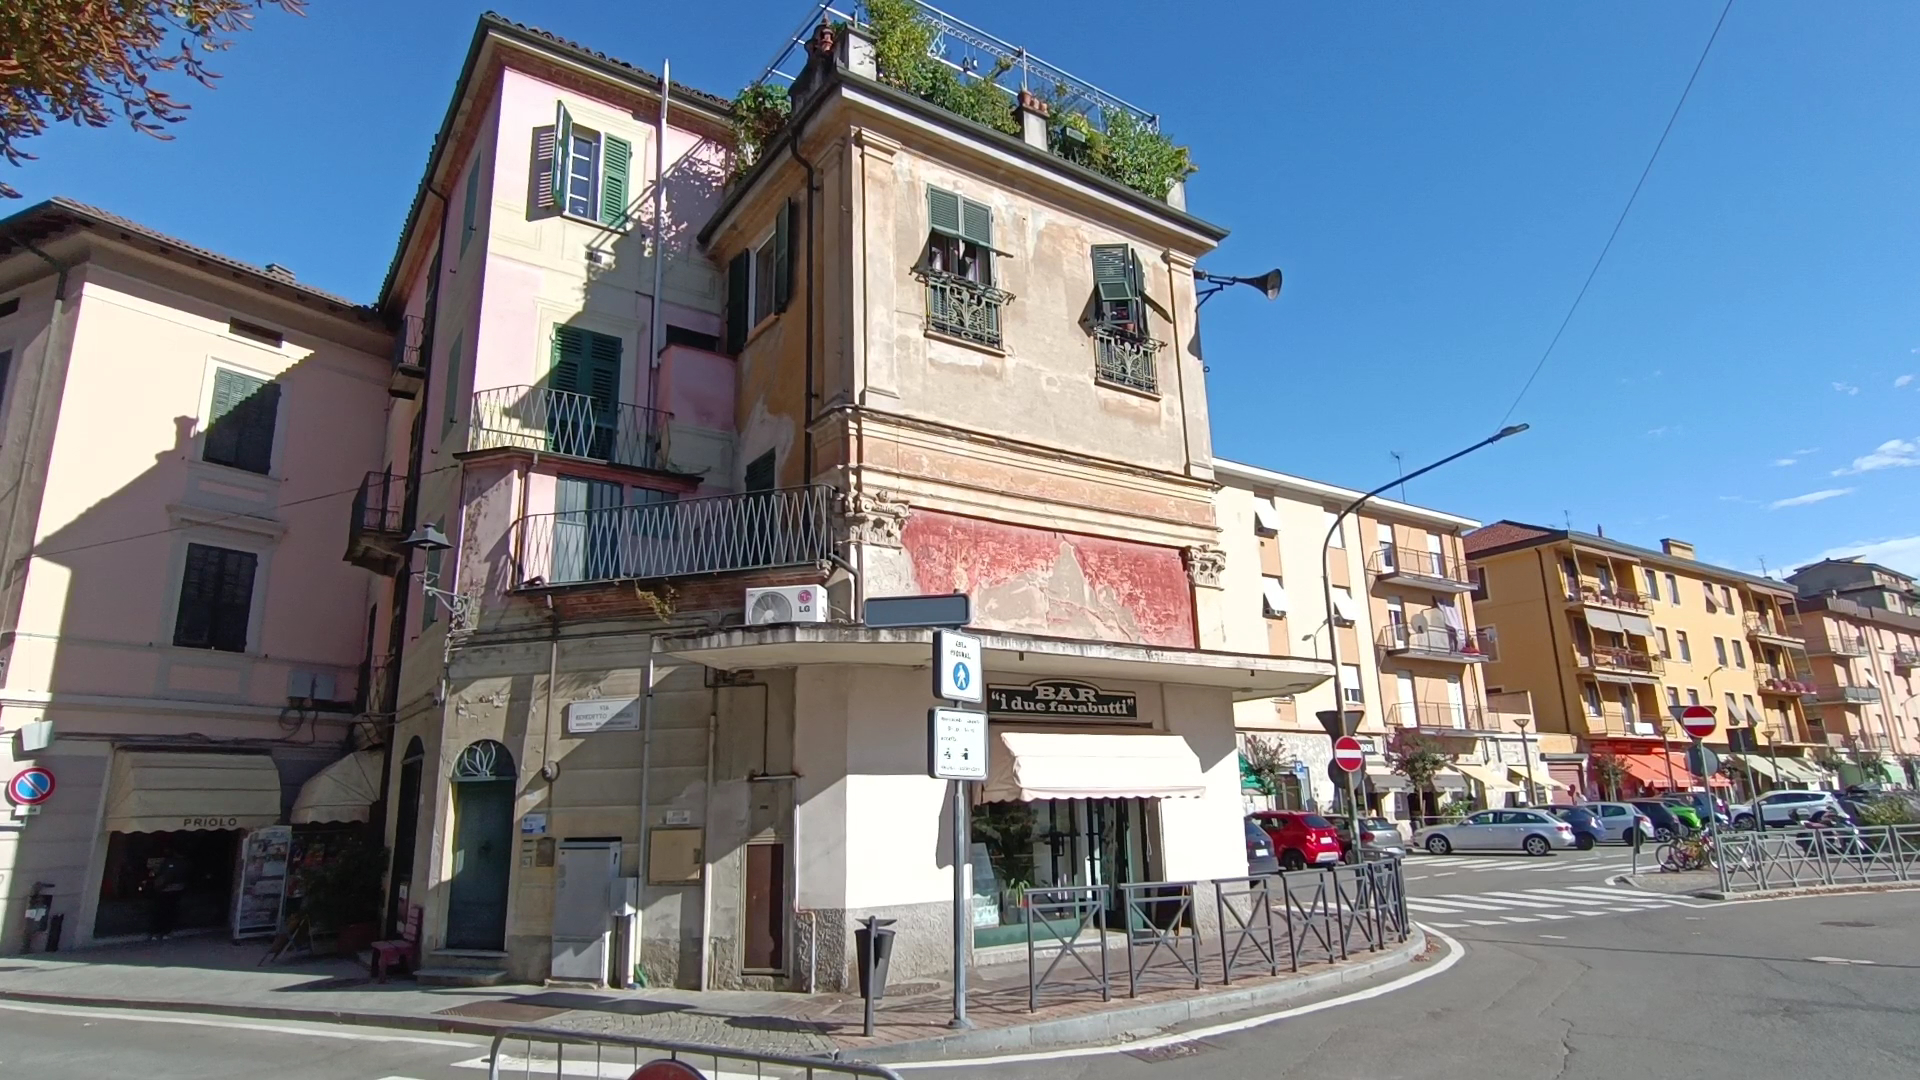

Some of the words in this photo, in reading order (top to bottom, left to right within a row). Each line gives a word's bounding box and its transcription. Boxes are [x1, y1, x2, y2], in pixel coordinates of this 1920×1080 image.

[798, 605, 811, 613] LG
[1035, 686, 1097, 702] BAR
[1011, 696, 1046, 711] due
[184, 817, 237, 827] PRIOLO
